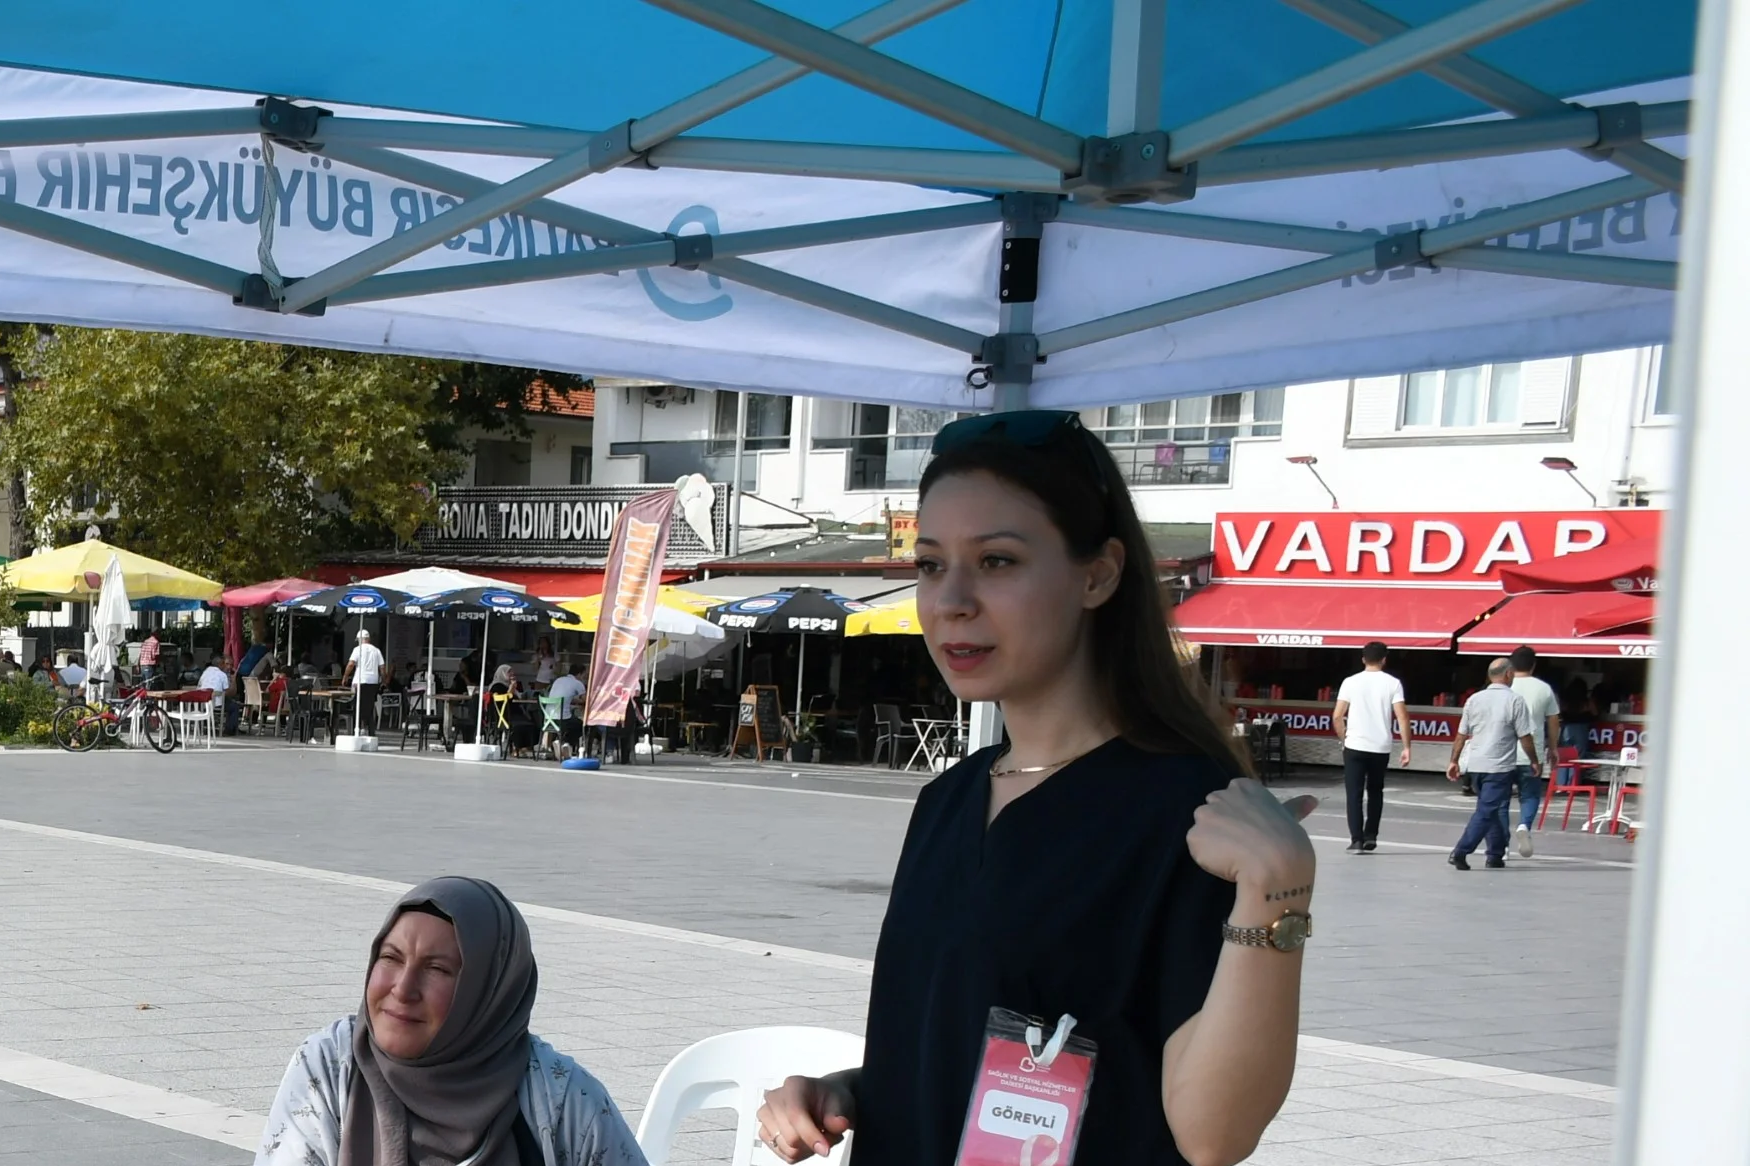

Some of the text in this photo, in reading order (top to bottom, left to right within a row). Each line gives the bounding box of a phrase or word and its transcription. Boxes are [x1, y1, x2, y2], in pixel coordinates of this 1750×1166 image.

[437, 502, 490, 540] ROMA
[499, 502, 553, 540] TADIM
[718, 614, 758, 629] PEPSI
[787, 617, 838, 631] PEPSI
[1256, 635, 1323, 645] VARDAR
[1618, 645, 1658, 656] VAR
[992, 1105, 1057, 1129] GÖREVLİ
